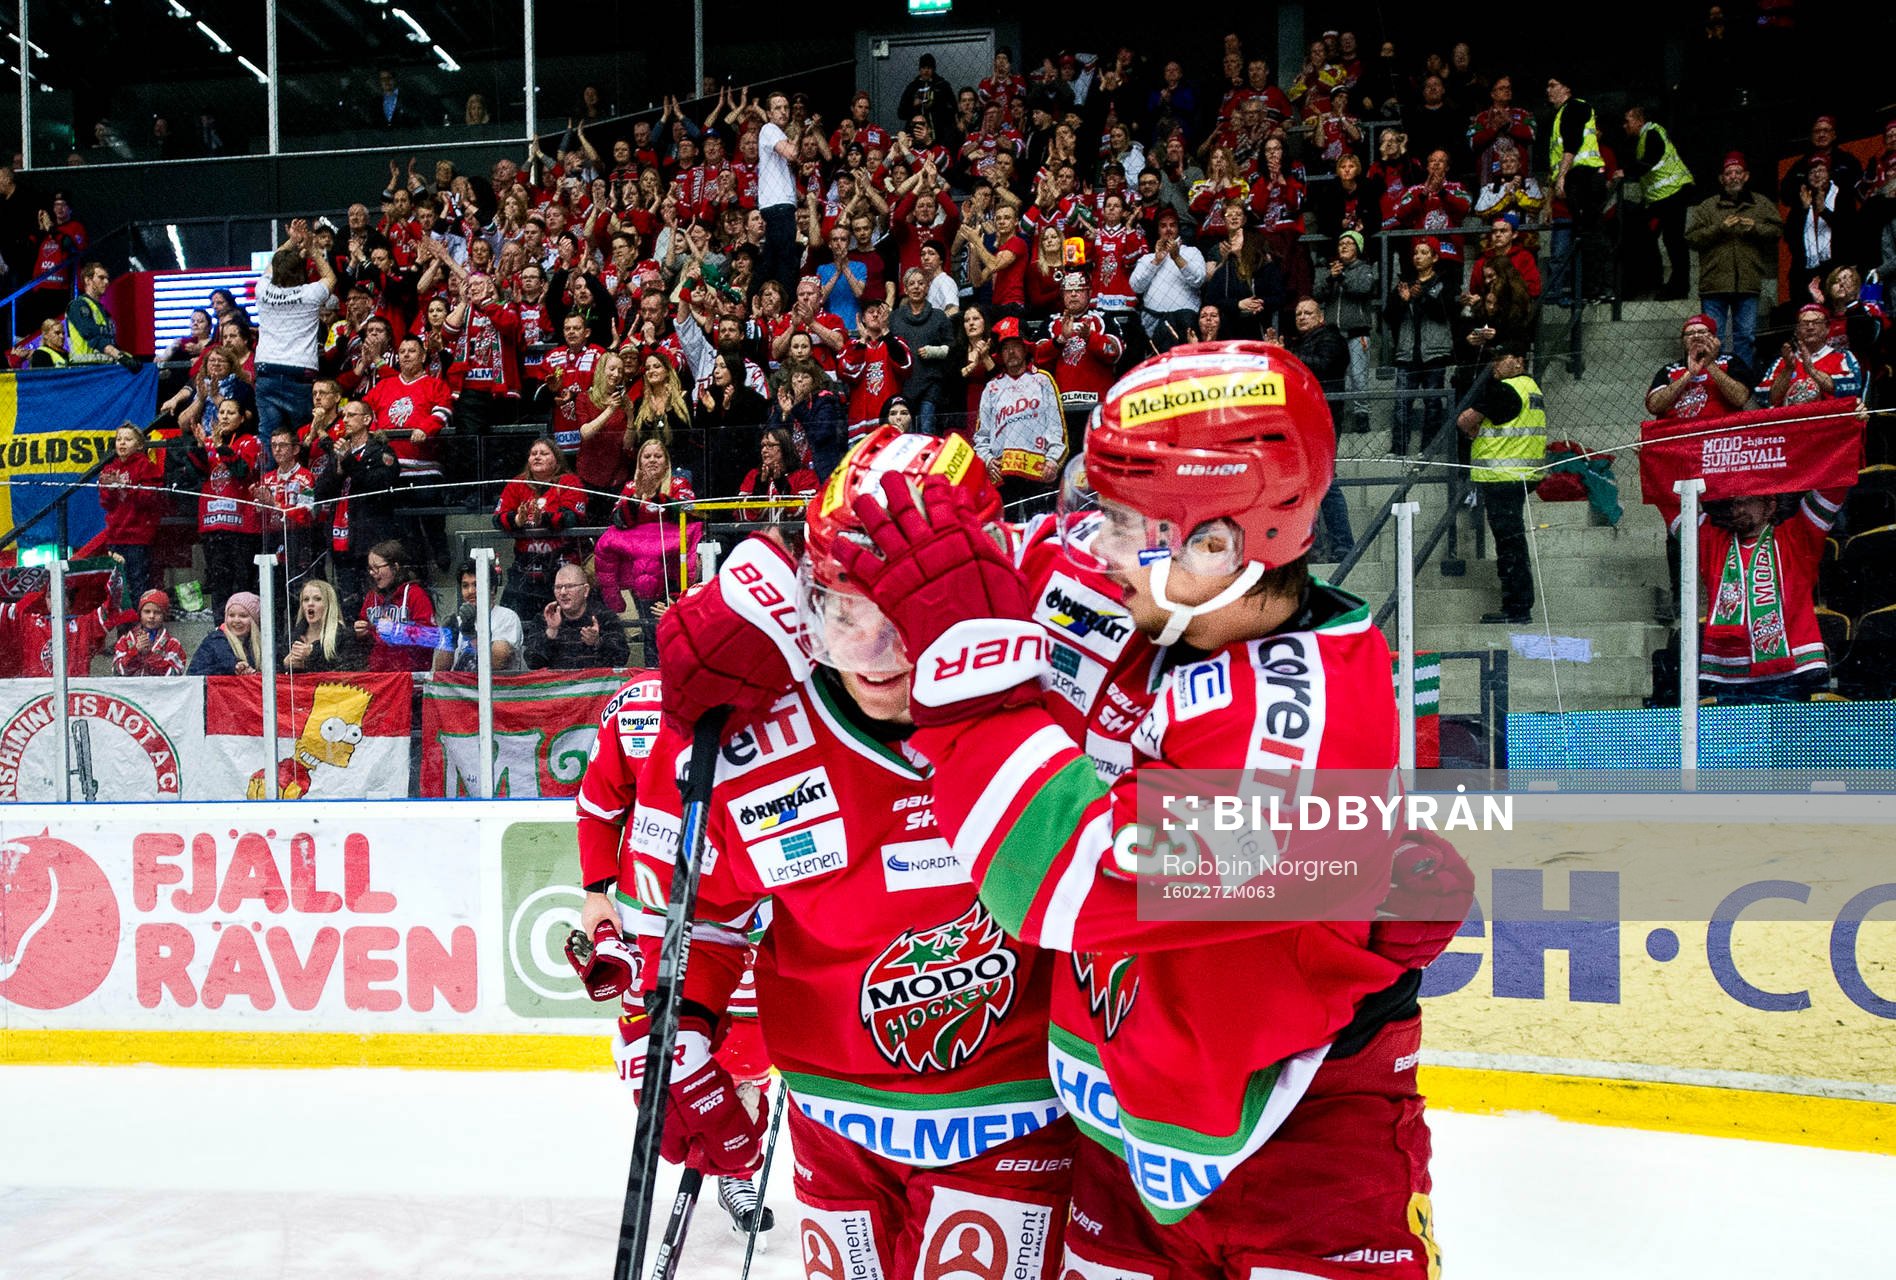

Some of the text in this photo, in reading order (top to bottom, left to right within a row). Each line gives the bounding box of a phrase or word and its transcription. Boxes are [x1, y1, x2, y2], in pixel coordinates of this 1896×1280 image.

[1060, 393, 1097, 401] OLMEN
[1702, 447, 1786, 467] SUNDSVALL
[73, 695, 98, 717] IS
[105, 701, 157, 746] NOT
[150, 750, 170, 767] A
[722, 703, 799, 766] eIT
[1253, 636, 1313, 807] coreIT
[132, 828, 398, 914] FJÄLL
[767, 850, 844, 884] Lerstenen
[911, 855, 961, 872] NORDTR
[135, 921, 478, 1013] RÄVEN
[867, 953, 1009, 1010] MODO
[885, 978, 1003, 1050] HOCKEY
[995, 1158, 1073, 1172] BAUER
[841, 1217, 869, 1280] lement
[1014, 1210, 1039, 1280] ement
[1071, 1205, 1104, 1236] UER
